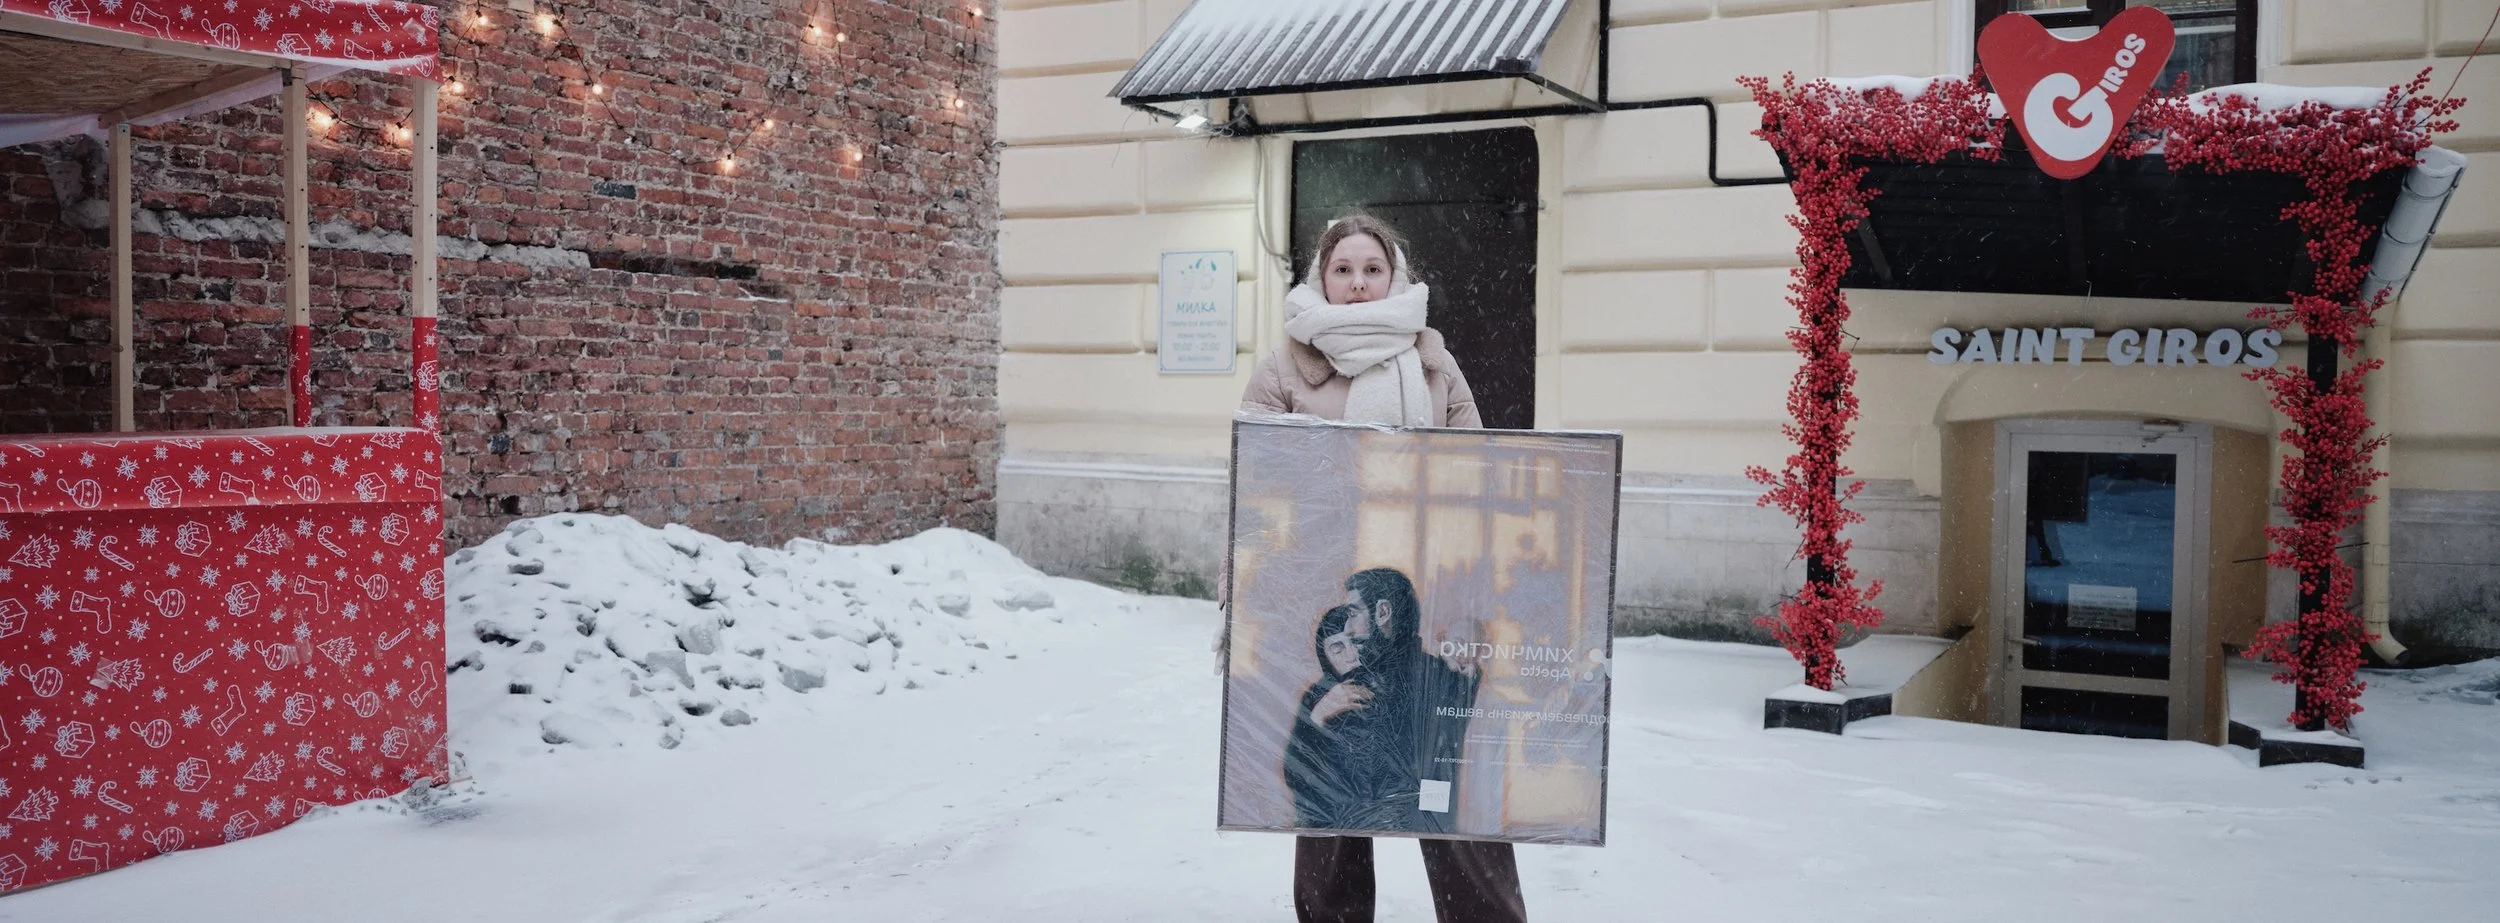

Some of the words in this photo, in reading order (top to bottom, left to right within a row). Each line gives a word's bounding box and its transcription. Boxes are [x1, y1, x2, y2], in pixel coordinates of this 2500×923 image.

[2024, 33, 2146, 161] GIROS
[1176, 301, 1216, 314] МИЛКА
[1926, 327, 2096, 366] SAINT
[2106, 327, 2282, 368] GIROS
